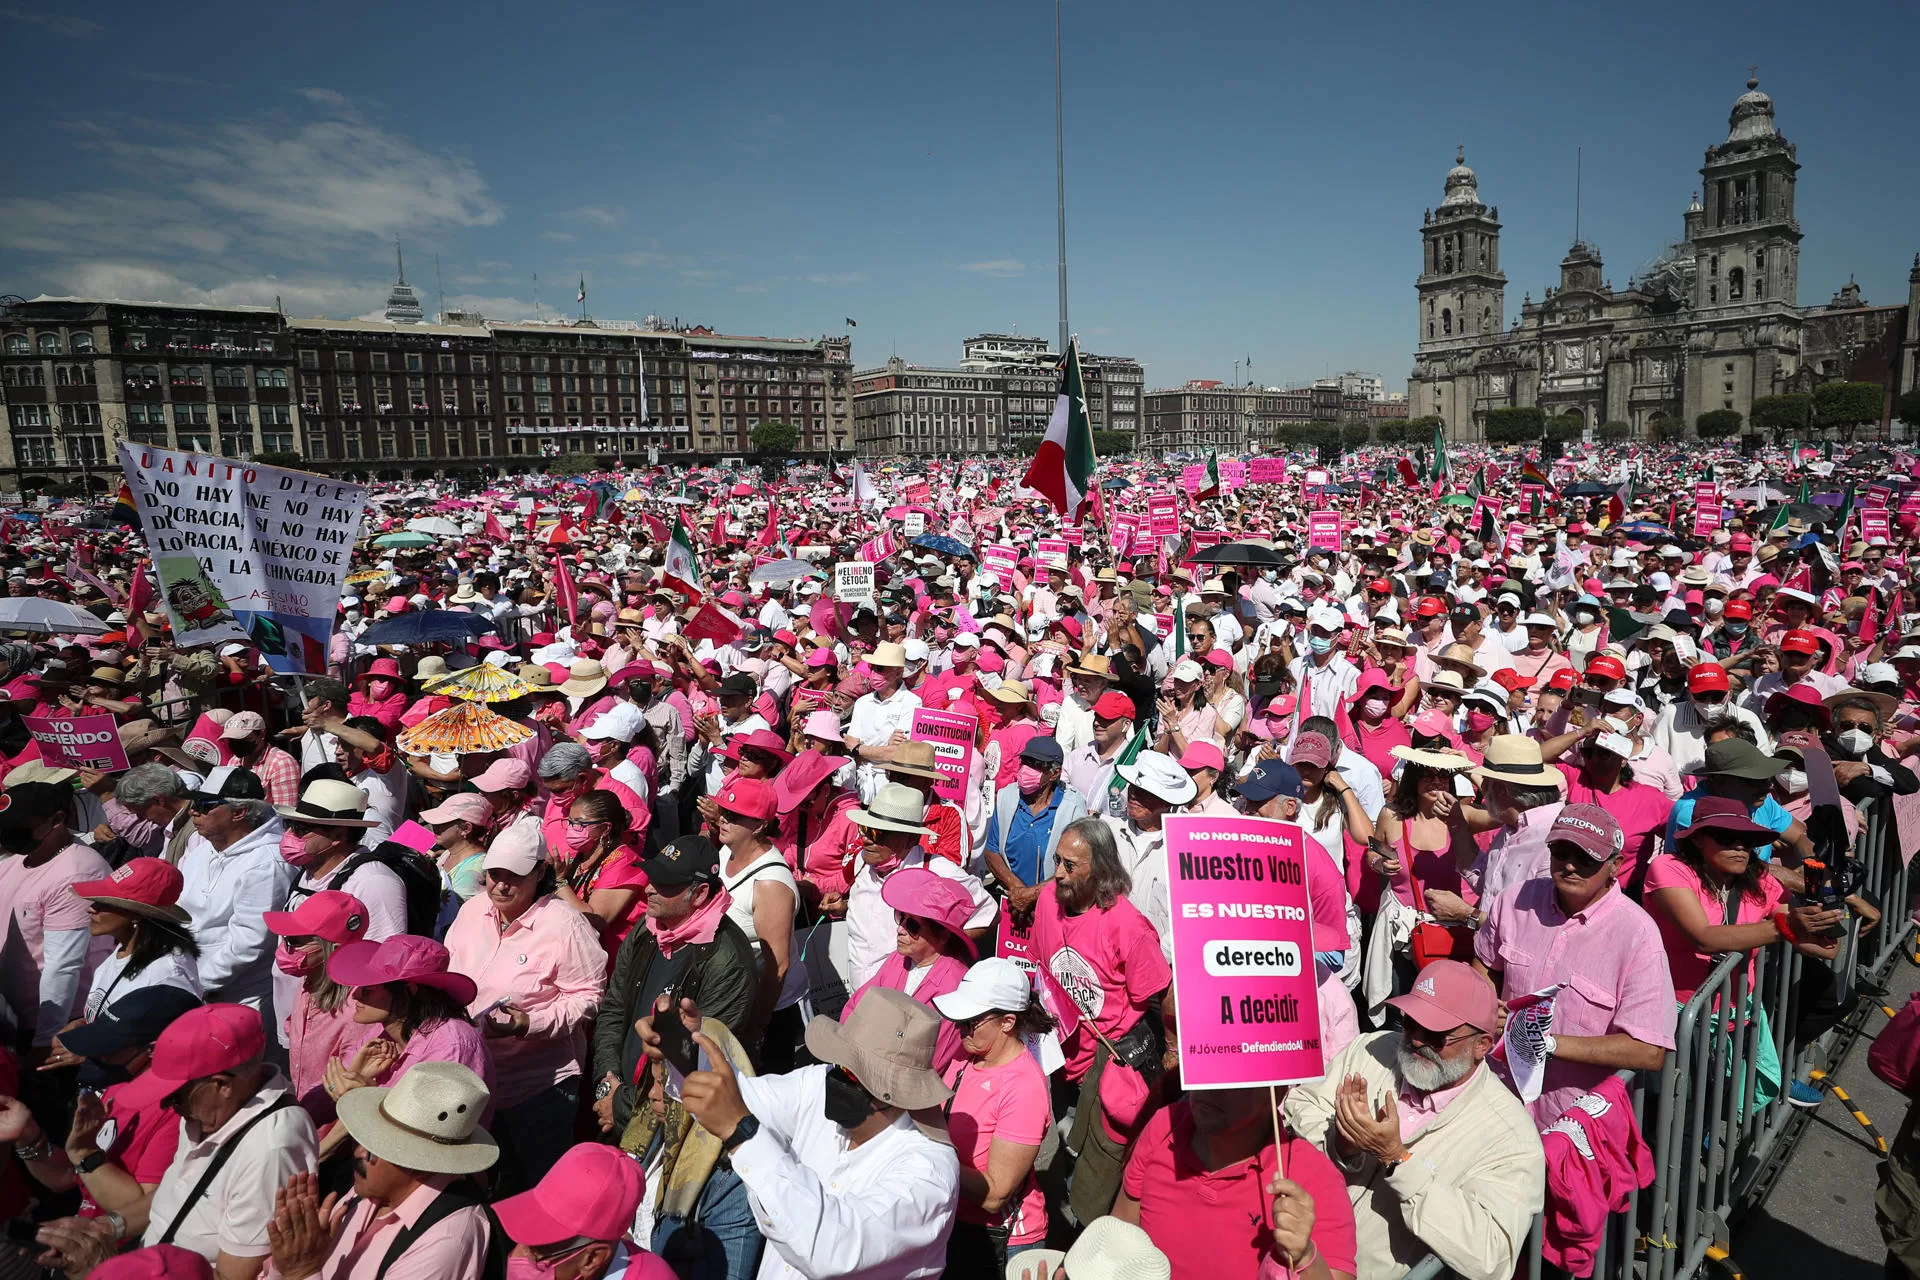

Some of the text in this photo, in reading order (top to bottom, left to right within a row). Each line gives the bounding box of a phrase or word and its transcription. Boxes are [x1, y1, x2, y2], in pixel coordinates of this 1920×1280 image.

[127, 449, 358, 503] UANITO DICE:
[155, 480, 179, 497] NO
[196, 485, 233, 503] HAY
[245, 491, 271, 510] INE
[284, 499, 308, 516] NO
[321, 506, 353, 524] HAY
[255, 516, 268, 532] SI
[280, 521, 304, 537] NO
[316, 527, 349, 544] HAY
[321, 550, 343, 565] SE
[229, 559, 251, 574] LA
[264, 563, 336, 586] CHINGADA
[838, 566, 873, 576] #ELINENO
[842, 576, 869, 585] SETOCA
[250, 589, 309, 606] ASESINO
[49, 722, 74, 733] YO
[916, 722, 972, 742] CONSTITUCIÓN
[32, 731, 113, 744] DEFIENDO
[62, 745, 82, 757] AL
[934, 761, 965, 774] VOTO
[1189, 831, 1292, 847] NO NOS ROBARÁN
[1179, 852, 1302, 886] Nuestro Voto
[1182, 903, 1305, 922] ES NUESTRO
[1215, 946, 1294, 967] derecho
[1220, 993, 1299, 1025] A decidir
